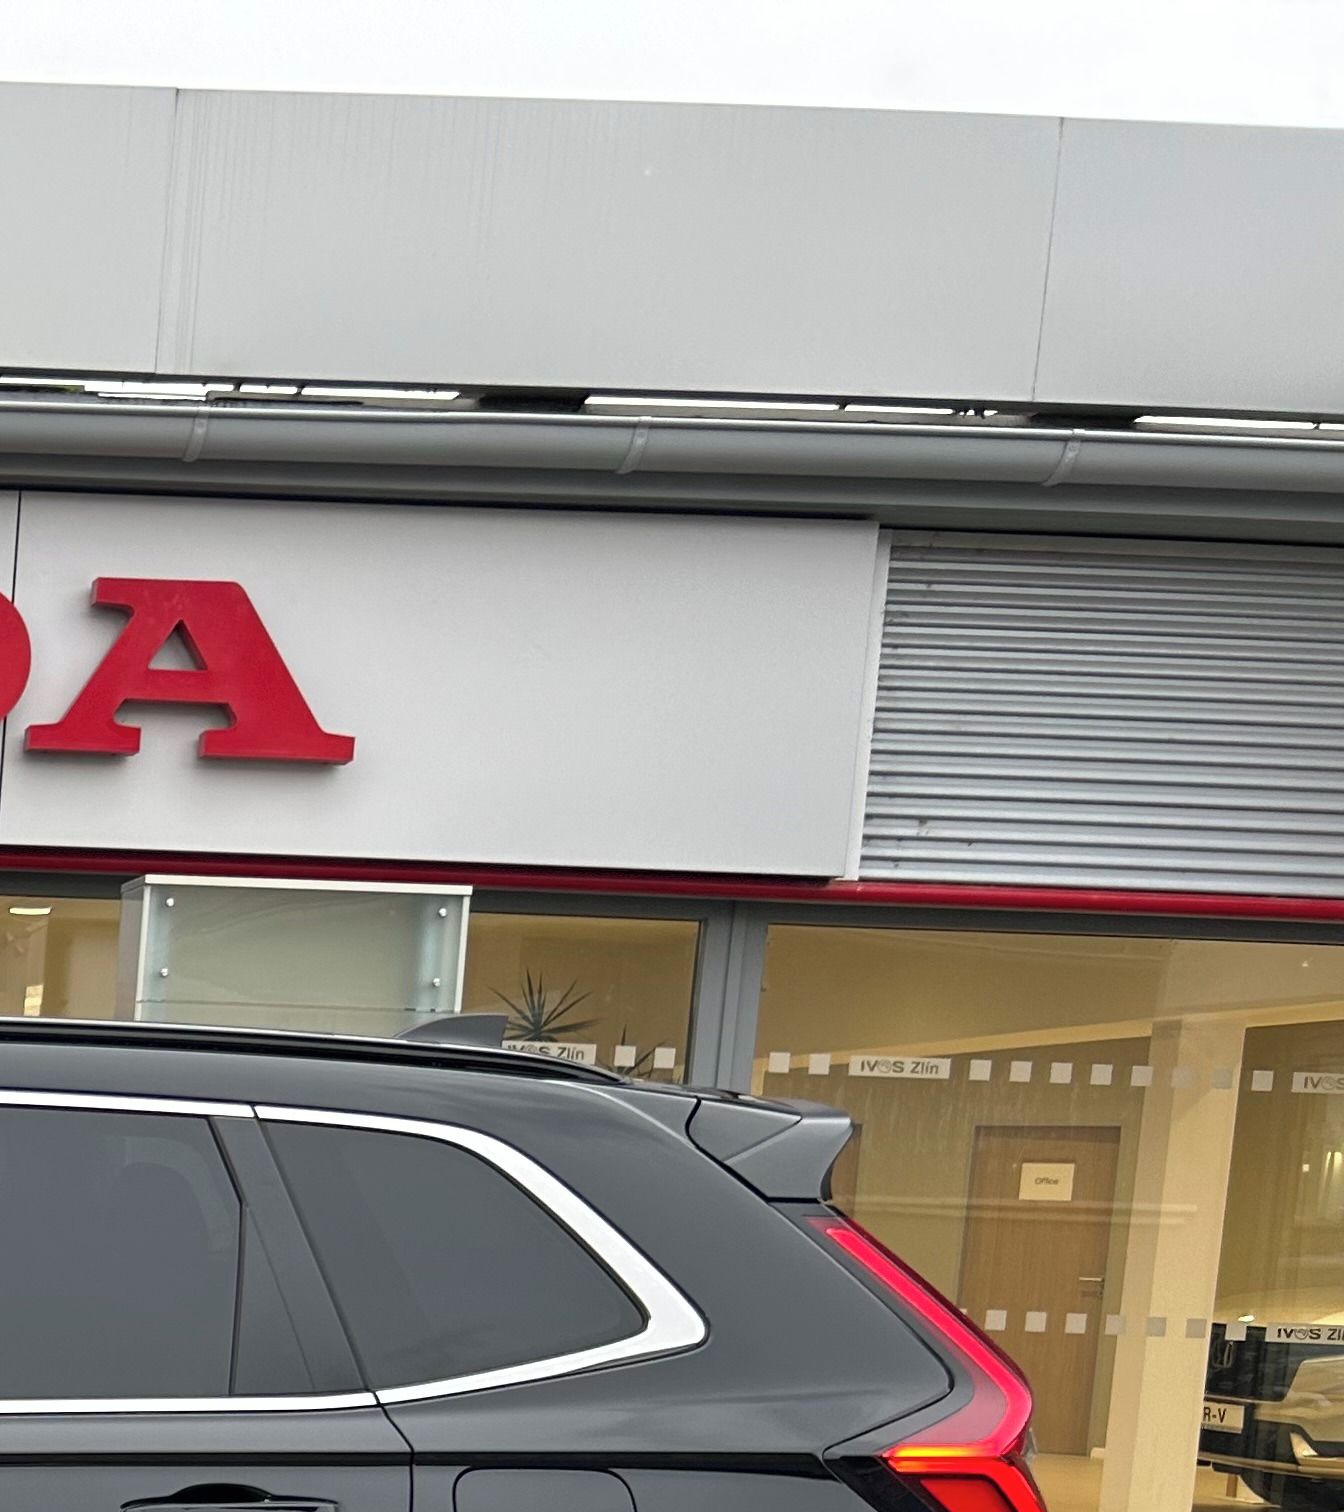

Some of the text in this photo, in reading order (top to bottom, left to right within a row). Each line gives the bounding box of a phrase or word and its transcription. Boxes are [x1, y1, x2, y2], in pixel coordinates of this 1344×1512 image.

[557, 1046, 585, 1060] Zlín
[909, 1061, 940, 1075] Zlín
[1035, 1177, 1059, 1185] Office
[1277, 1327, 1322, 1340] IVOS
[1203, 1406, 1227, 1424] R-V
